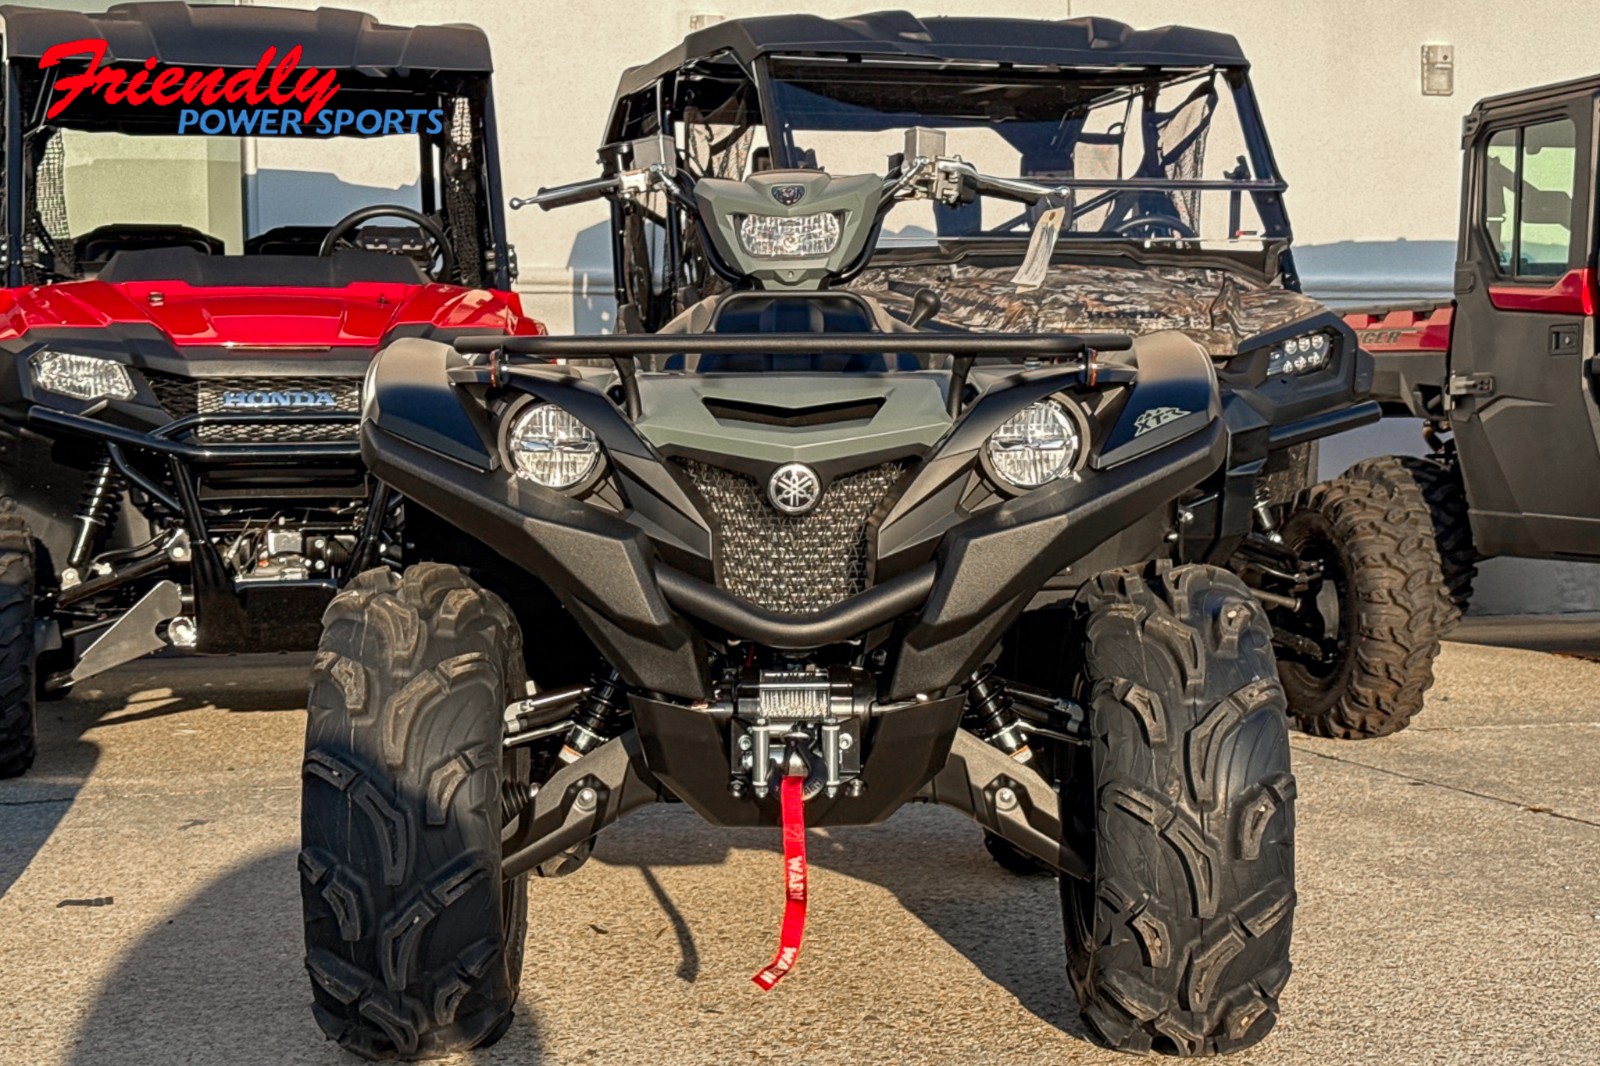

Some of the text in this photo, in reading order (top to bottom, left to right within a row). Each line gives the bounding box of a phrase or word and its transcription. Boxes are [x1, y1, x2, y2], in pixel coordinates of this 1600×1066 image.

[1360, 331, 1401, 344] GER
[223, 391, 337, 407] HONDA
[803, 777, 823, 796] ARN
